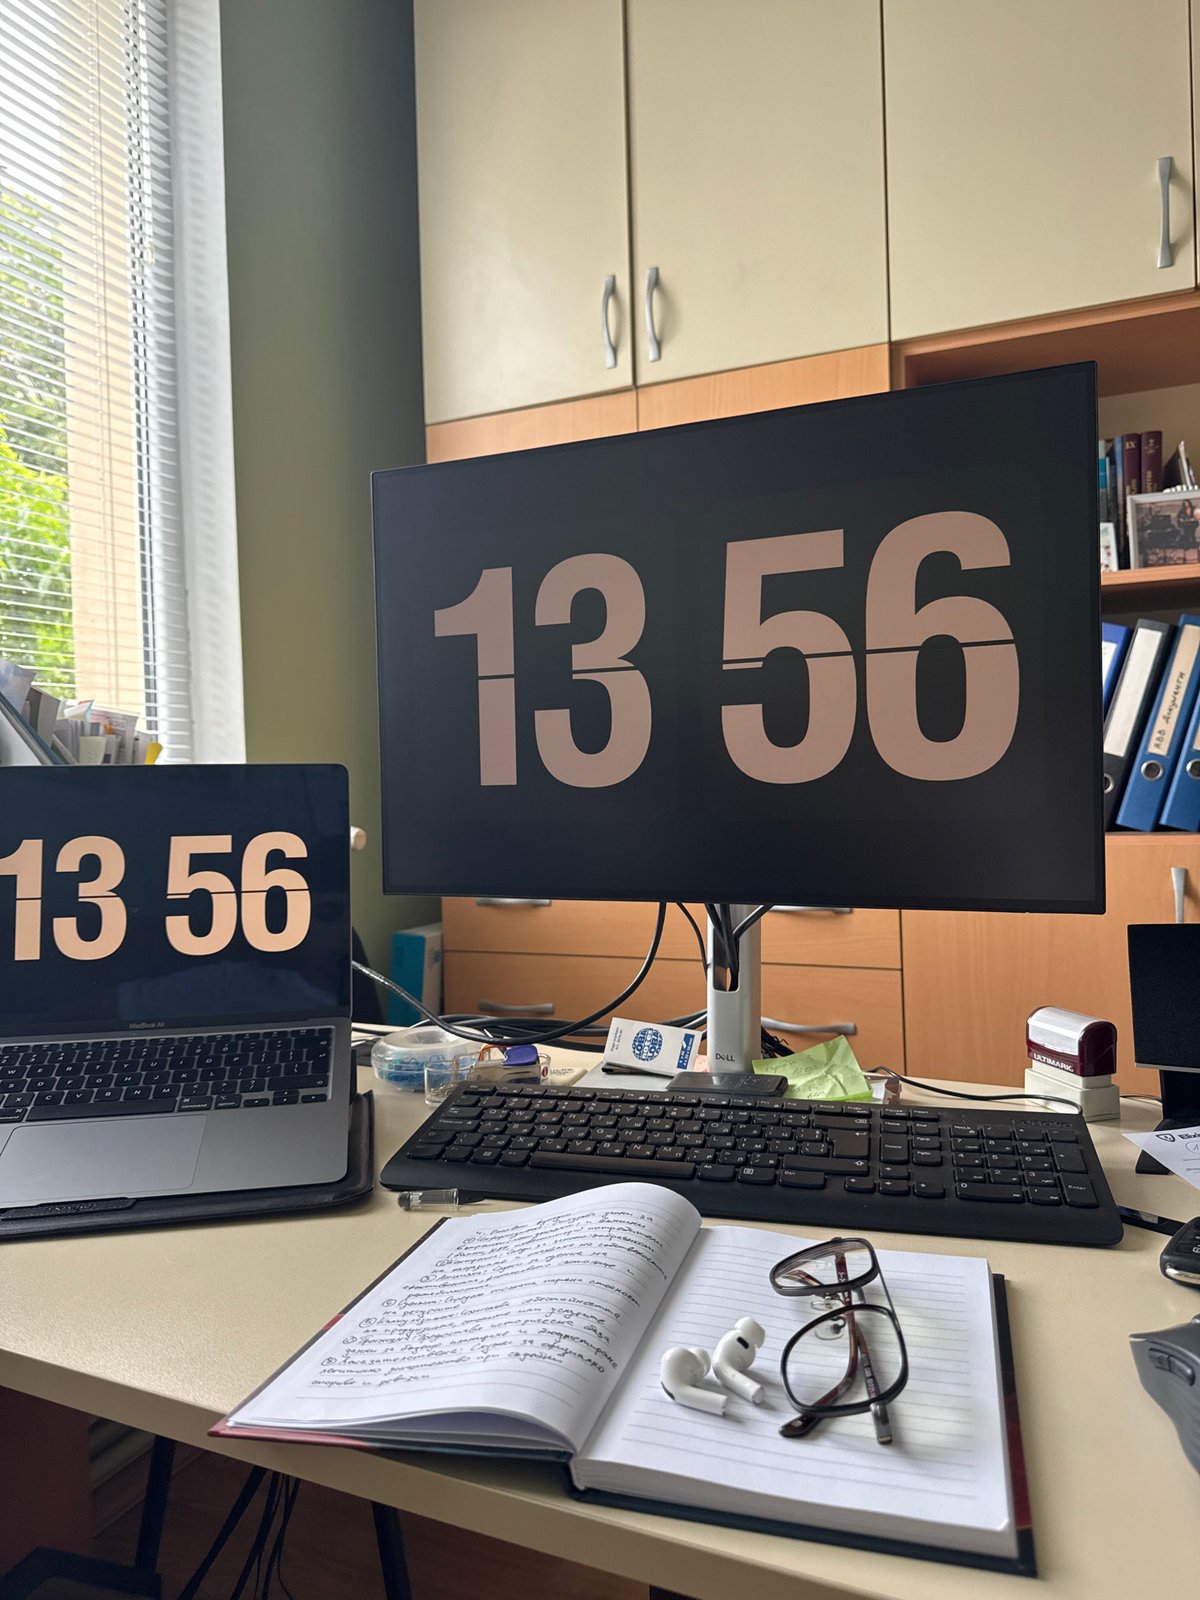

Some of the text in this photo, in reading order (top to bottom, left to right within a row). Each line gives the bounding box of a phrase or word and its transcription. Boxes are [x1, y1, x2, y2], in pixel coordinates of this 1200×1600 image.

[434, 510, 1020, 788] 13 56
[0, 832, 310, 960] 13 56
[715, 1053, 735, 1062] DELL
